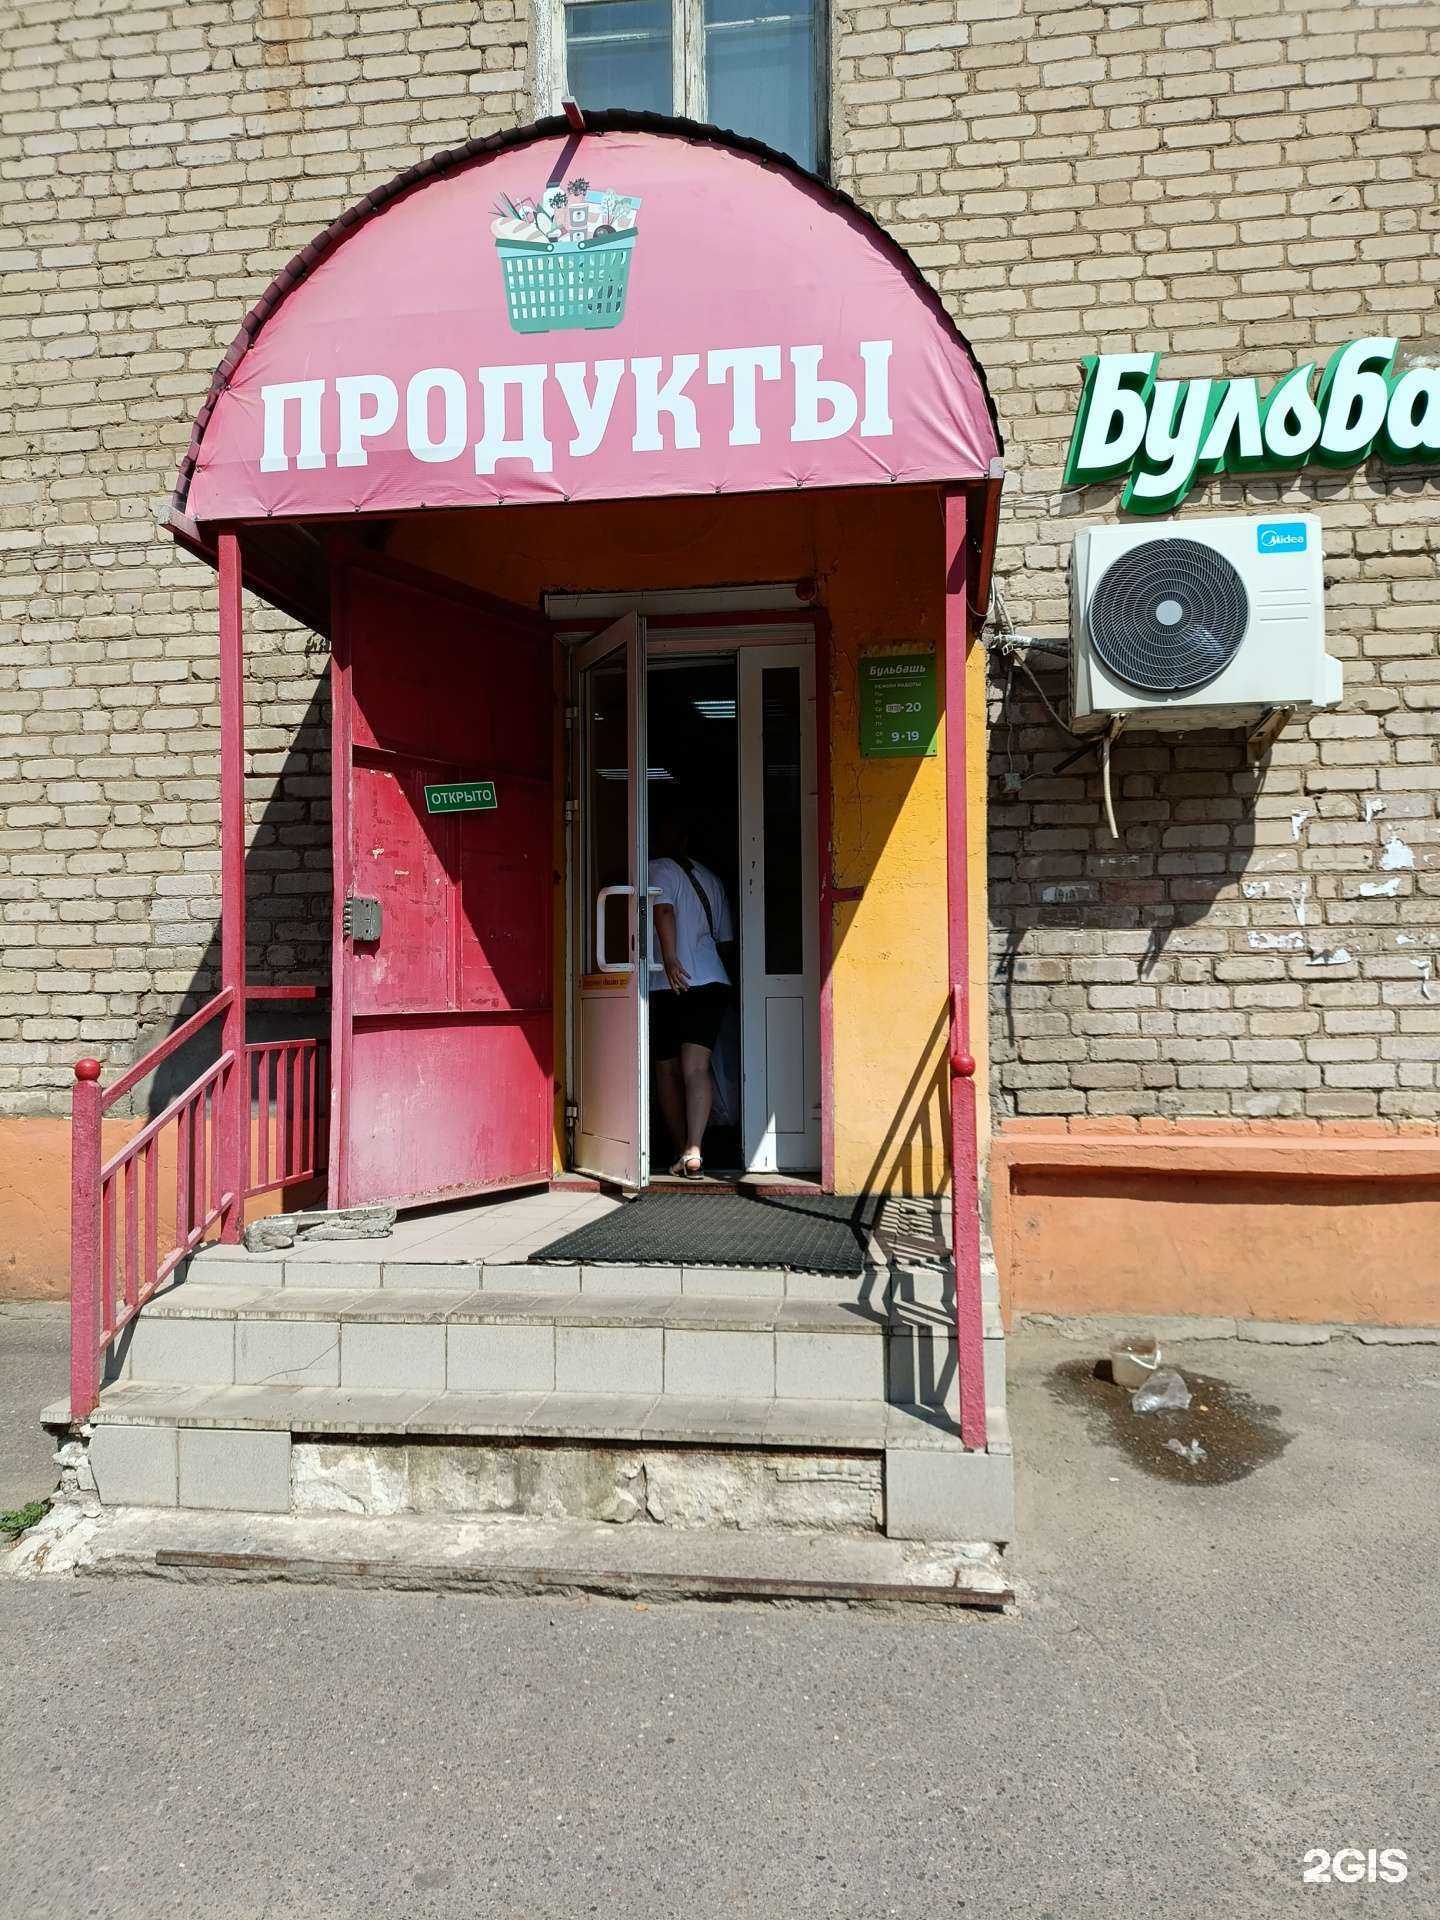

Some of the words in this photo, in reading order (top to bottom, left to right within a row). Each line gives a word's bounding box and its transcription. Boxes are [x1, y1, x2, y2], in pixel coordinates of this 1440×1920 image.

[259, 340, 894, 475] ПРОДУКТЫ
[1261, 529, 1305, 547] Midea
[869, 664, 926, 676] Бульбашь
[905, 702, 921, 713] 20
[431, 789, 492, 804] ОТКРЫТО
